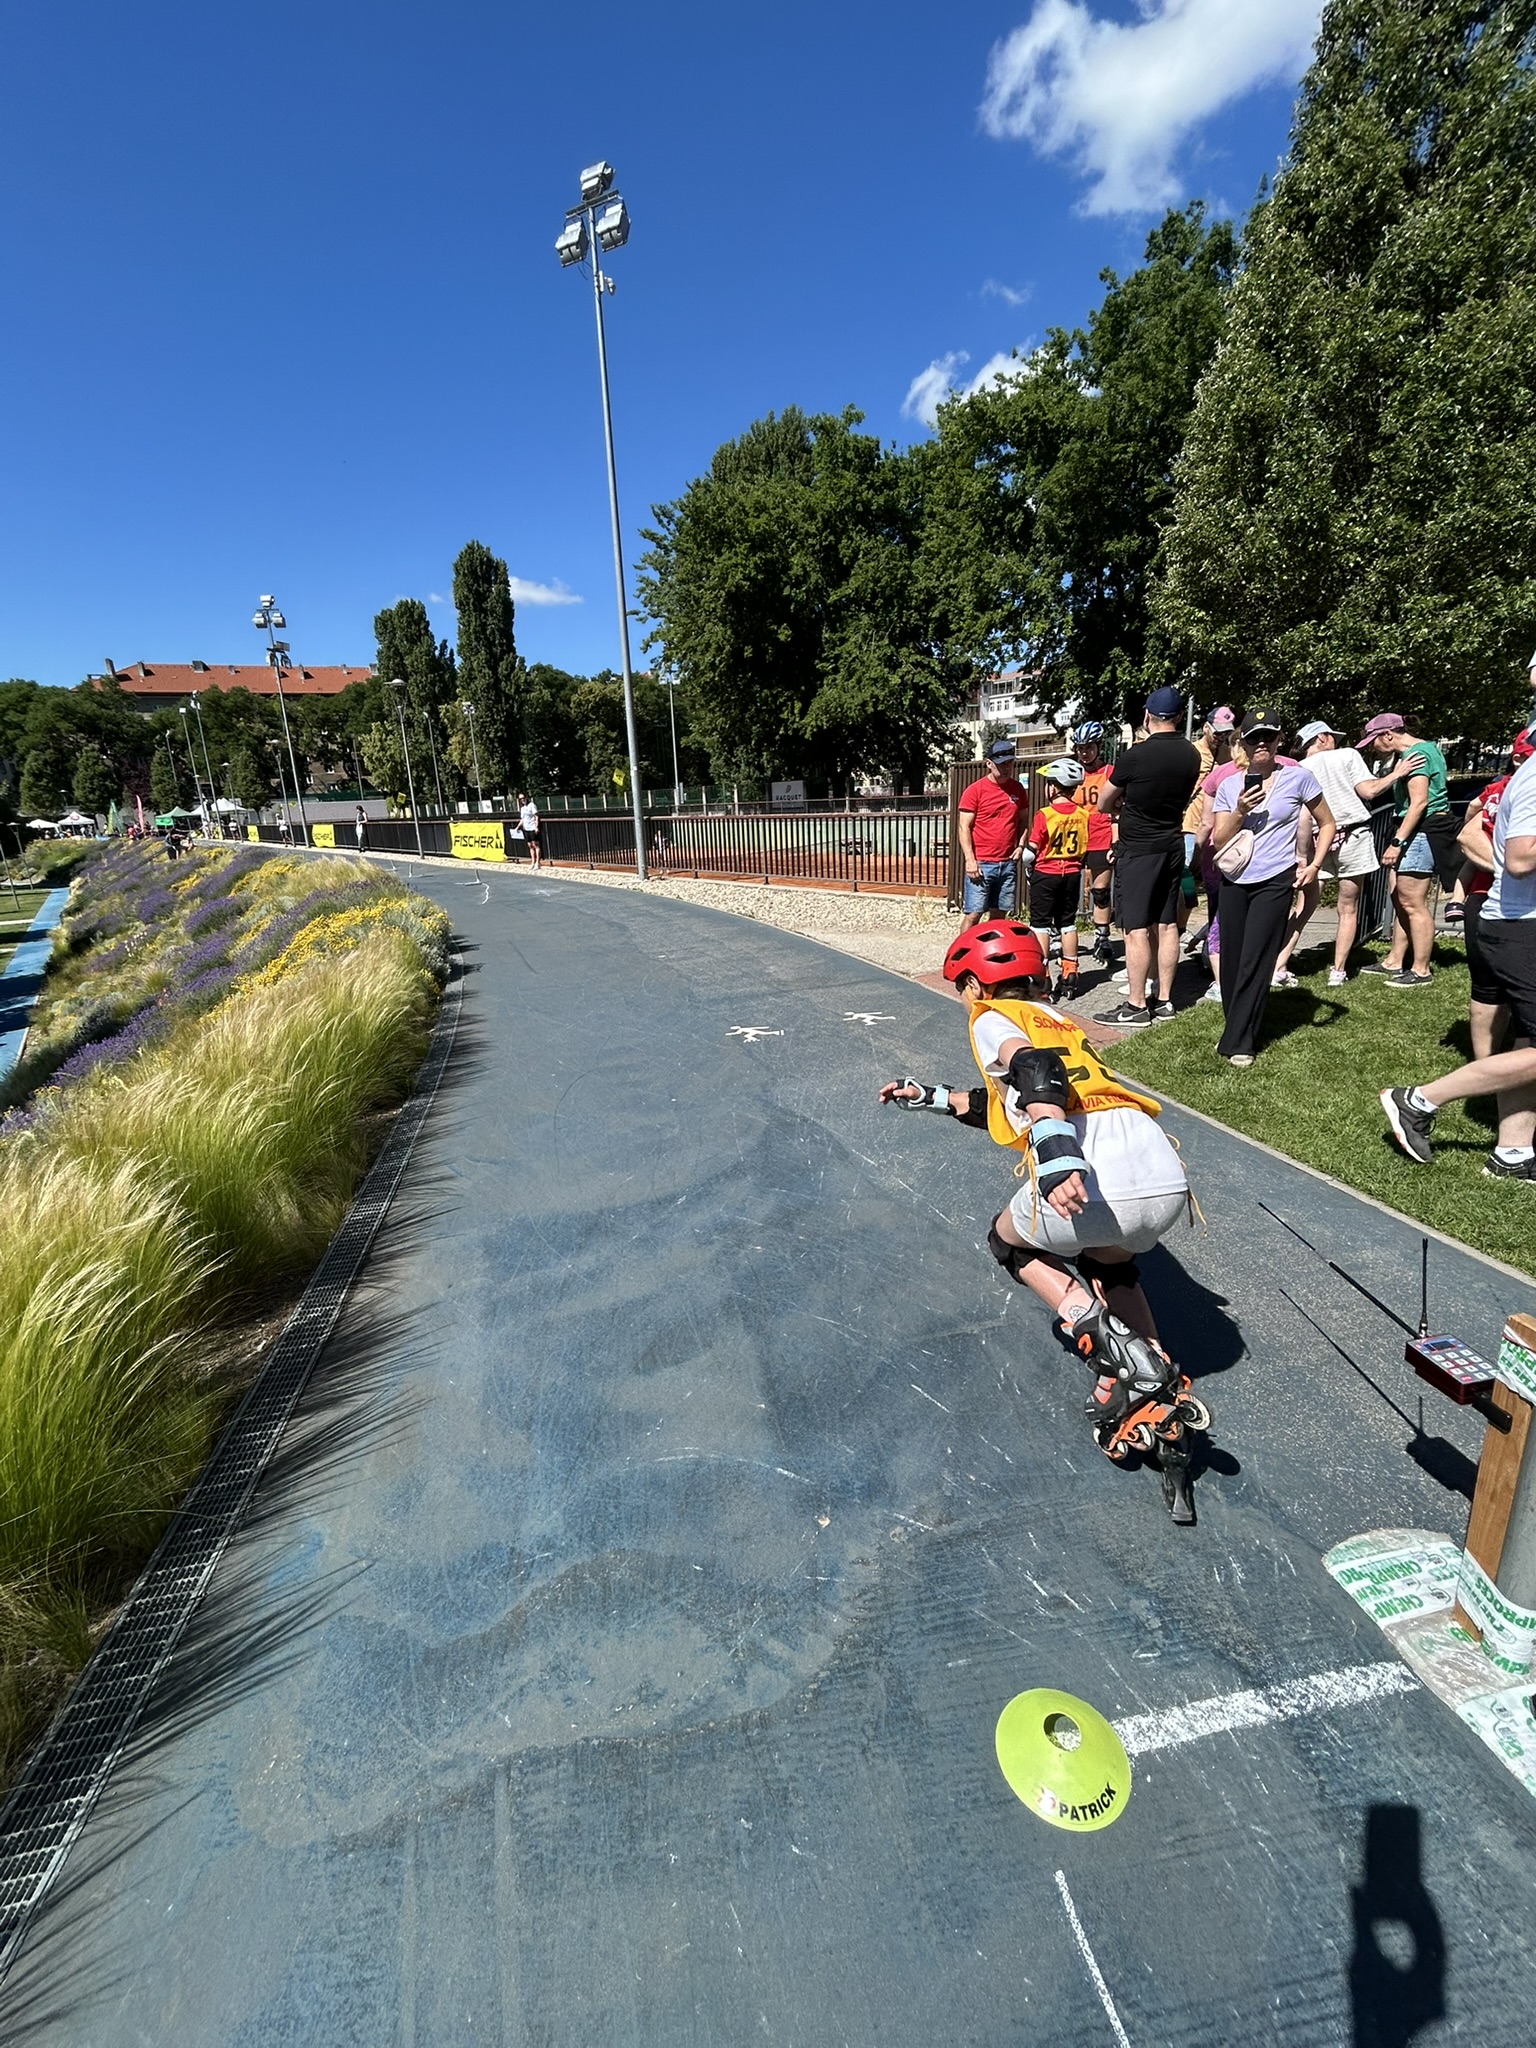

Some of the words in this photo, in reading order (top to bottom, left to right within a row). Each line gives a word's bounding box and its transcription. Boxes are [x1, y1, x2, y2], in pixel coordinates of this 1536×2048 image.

[1081, 785, 1099, 806] 16
[453, 835, 495, 849] FISCHER
[1051, 830, 1079, 855] 43
[1058, 1781, 1117, 1821] PATRICK
